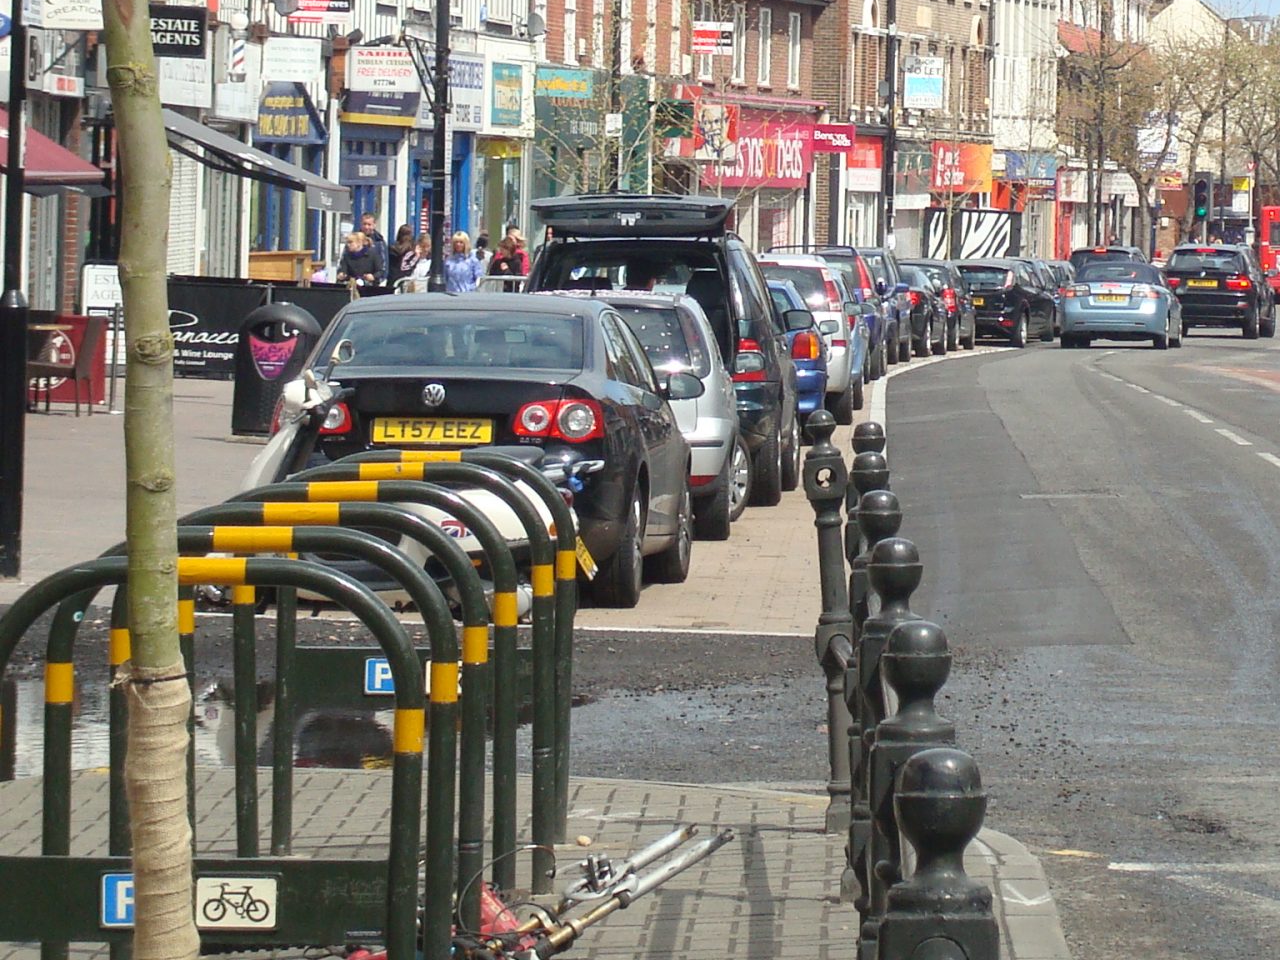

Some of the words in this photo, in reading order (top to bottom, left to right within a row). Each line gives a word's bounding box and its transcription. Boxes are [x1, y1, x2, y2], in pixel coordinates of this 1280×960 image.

[149, 18, 200, 32] ESTATE
[150, 33, 201, 46] AGENTS
[924, 67, 942, 76] LET
[181, 350, 202, 358] Wine
[203, 350, 234, 361] Lounge
[383, 421, 437, 438] LT57
[442, 421, 482, 440] EEZ
